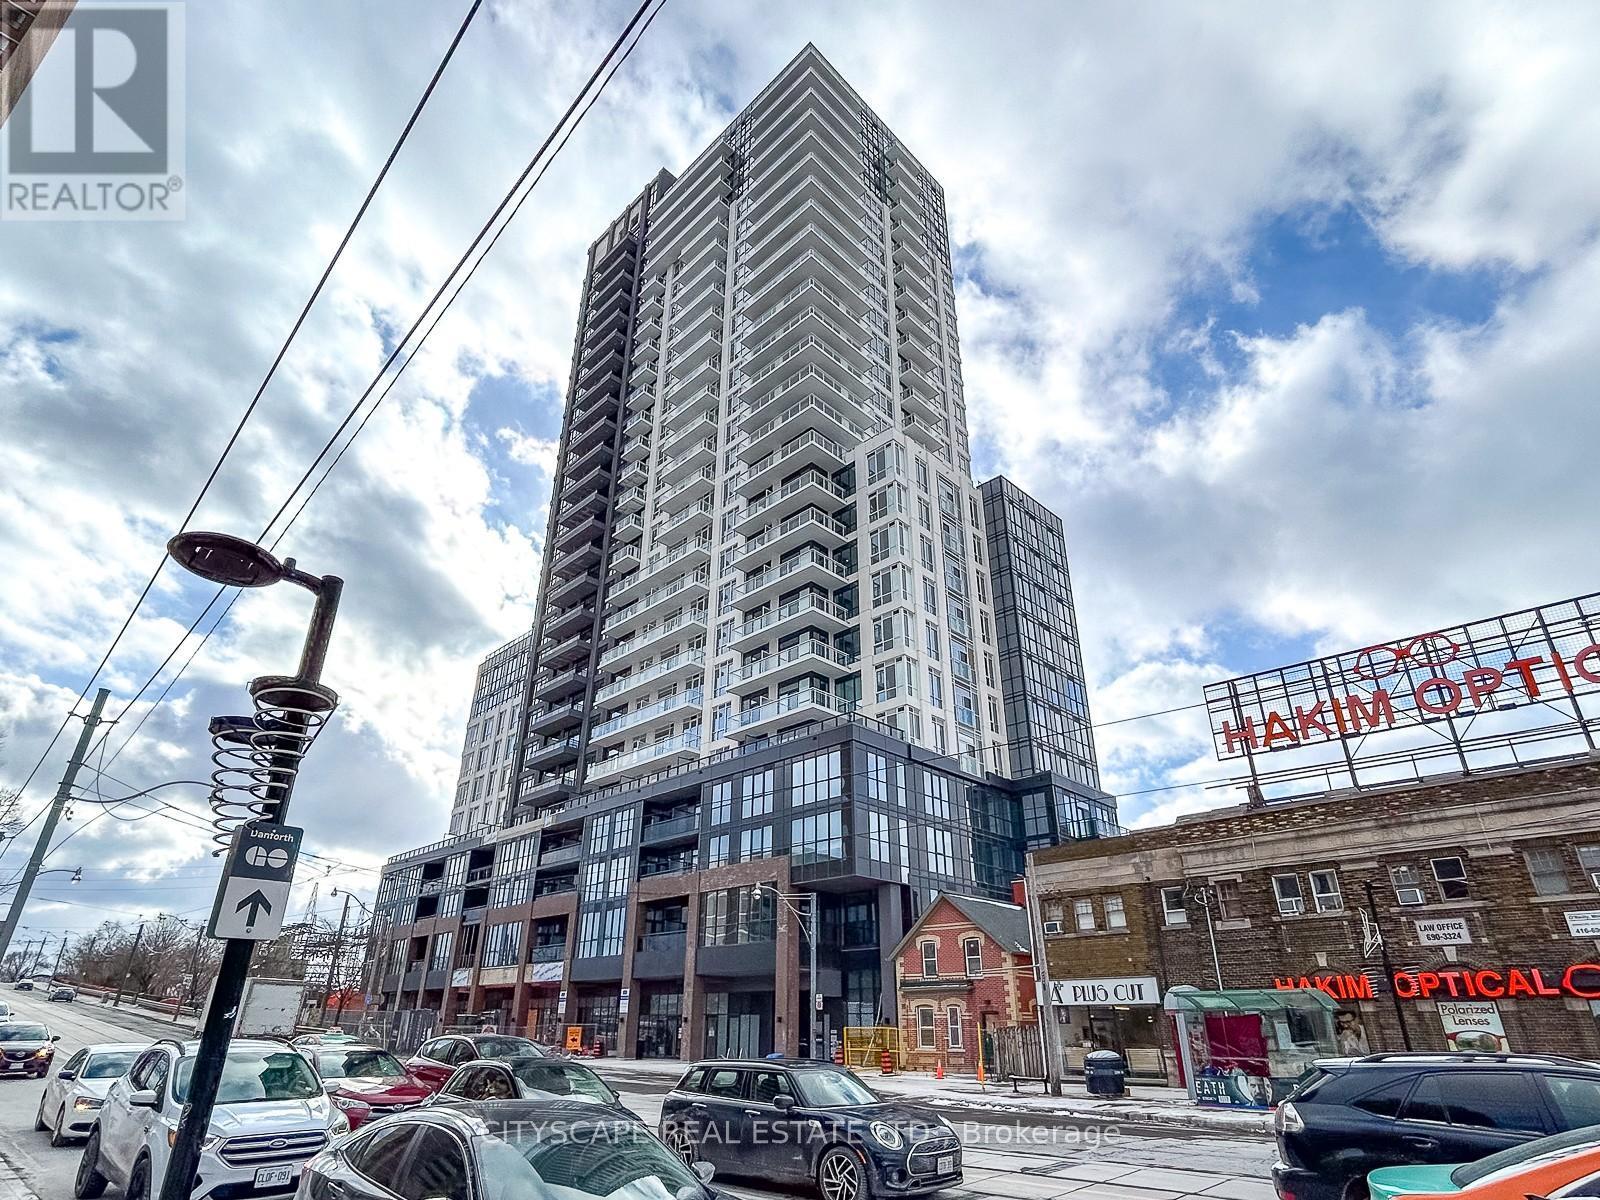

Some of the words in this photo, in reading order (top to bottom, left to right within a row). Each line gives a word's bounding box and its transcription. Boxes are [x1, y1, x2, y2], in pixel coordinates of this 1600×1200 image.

[1222, 689, 1396, 753] HAKIM
[250, 829, 294, 842] Danforth
[1419, 924, 1435, 932] LAW
[1436, 922, 1464, 931] OFFICE
[1274, 974, 1374, 999] HAKIM
[1394, 967, 1560, 998] OPTICAL
[1072, 985, 1109, 1002] PLUS
[1114, 983, 1144, 1001] CUT
[1441, 1003, 1496, 1016] Polarized
[1453, 1016, 1491, 1026] Lenses
